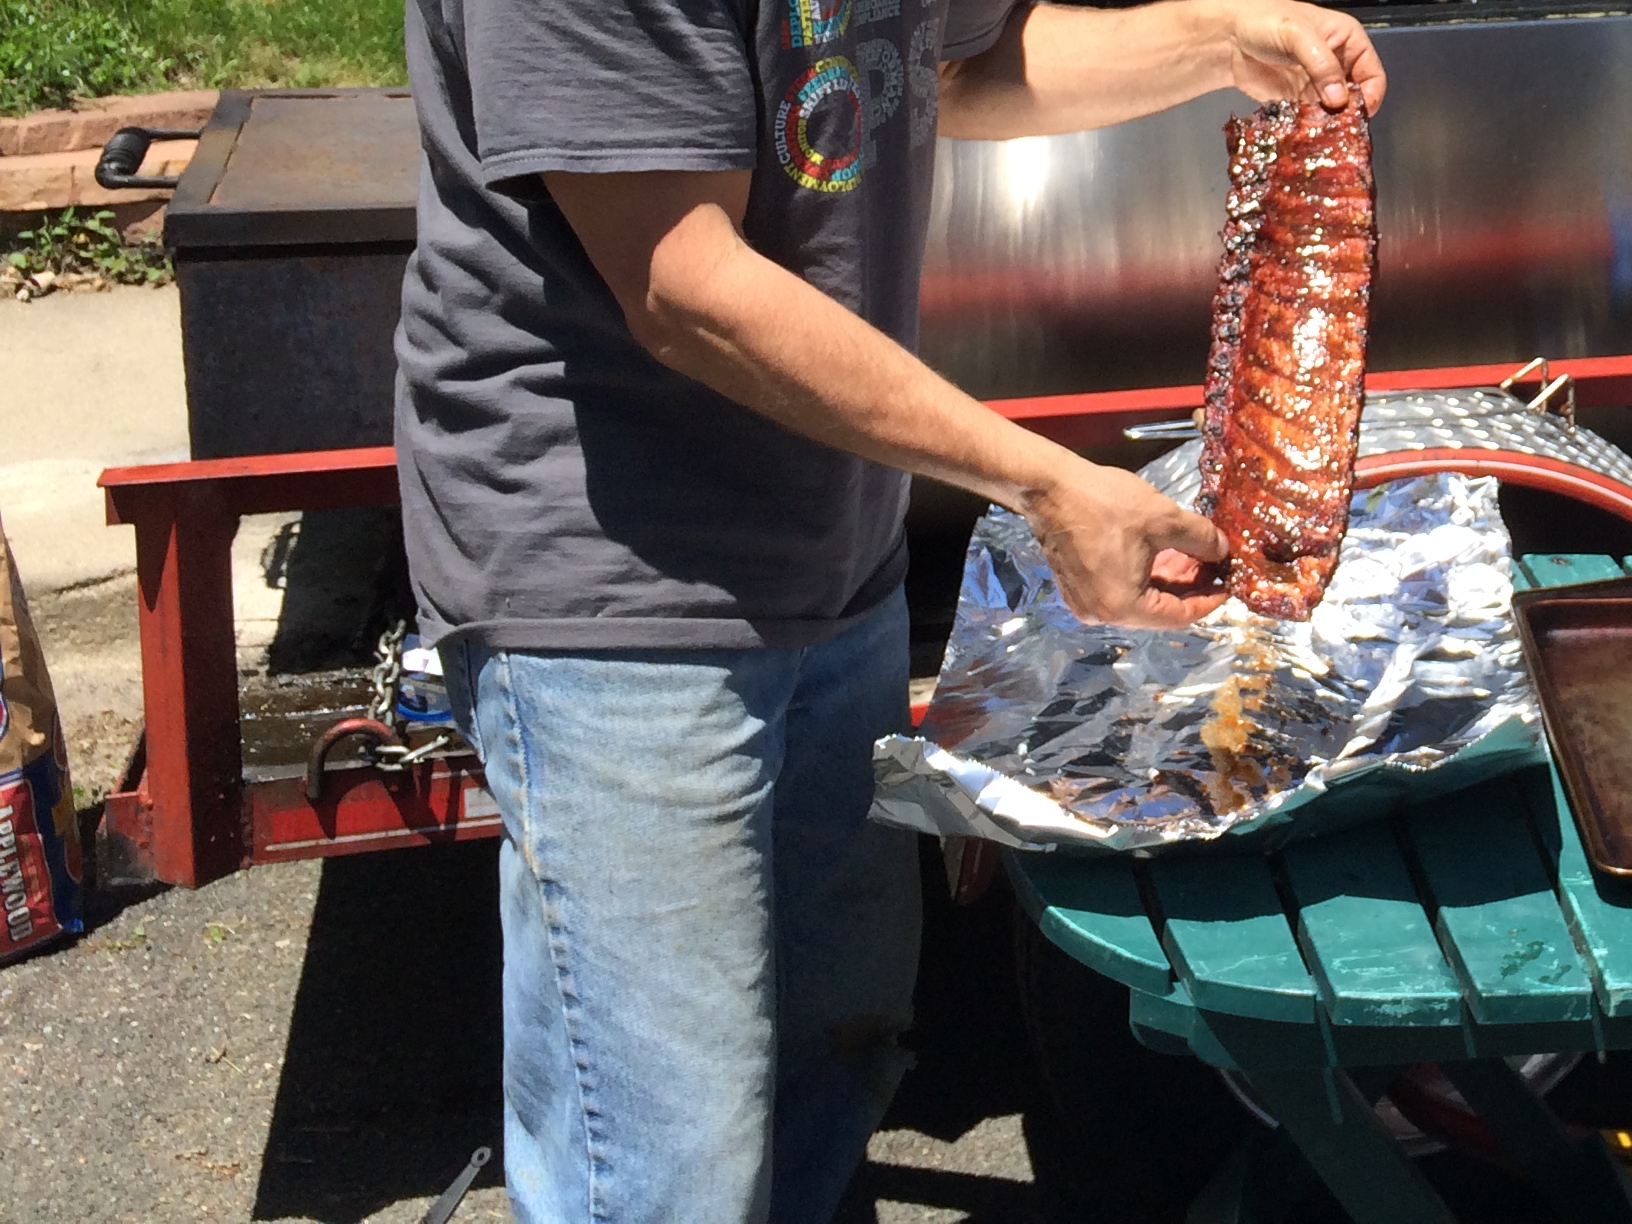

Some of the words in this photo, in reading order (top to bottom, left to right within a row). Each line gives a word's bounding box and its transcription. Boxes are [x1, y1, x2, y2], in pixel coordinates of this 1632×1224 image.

[774, 99, 792, 165] CULTURE
[797, 118, 825, 165] MONITOR
[0, 803, 34, 943] APPLEWOOD
